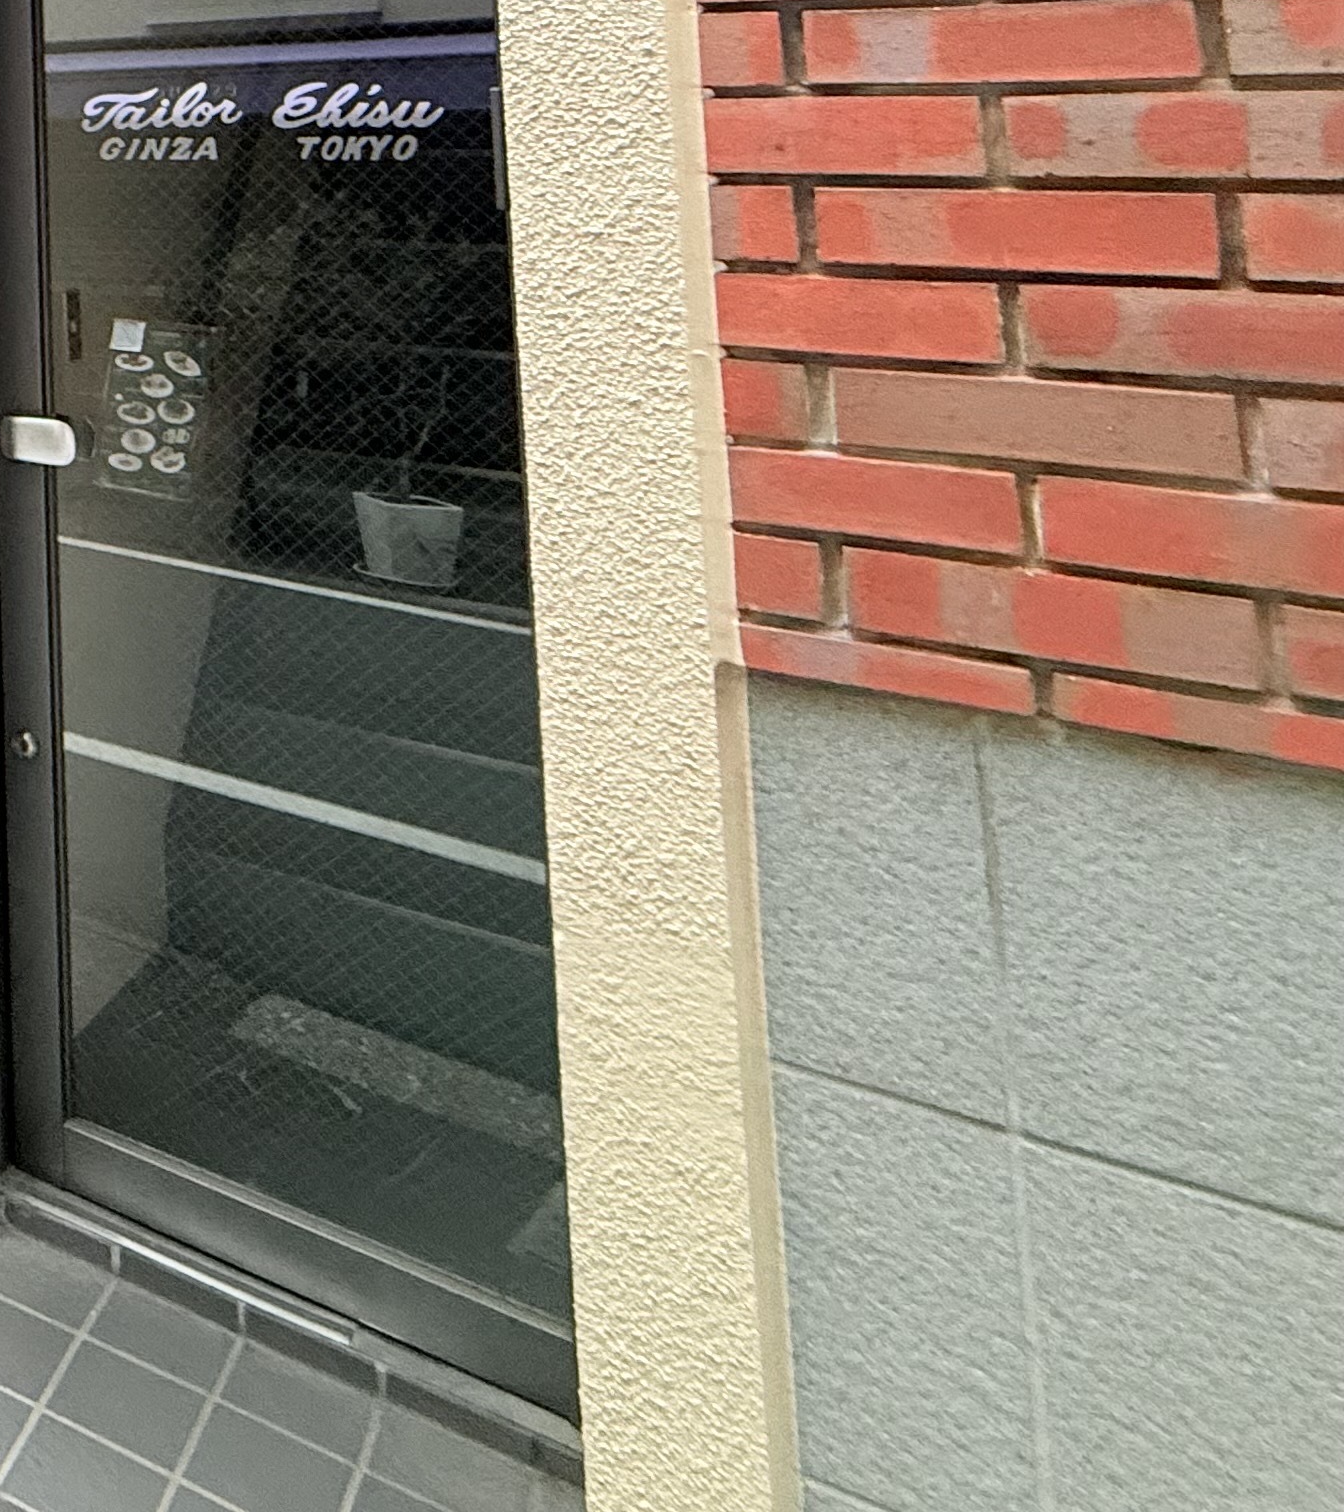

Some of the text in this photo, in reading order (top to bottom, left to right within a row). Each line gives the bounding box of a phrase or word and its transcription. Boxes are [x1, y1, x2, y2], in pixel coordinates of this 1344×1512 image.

[81, 81, 445, 133] Tailor Ebisu
[99, 134, 419, 162] GINZA TOKYO
